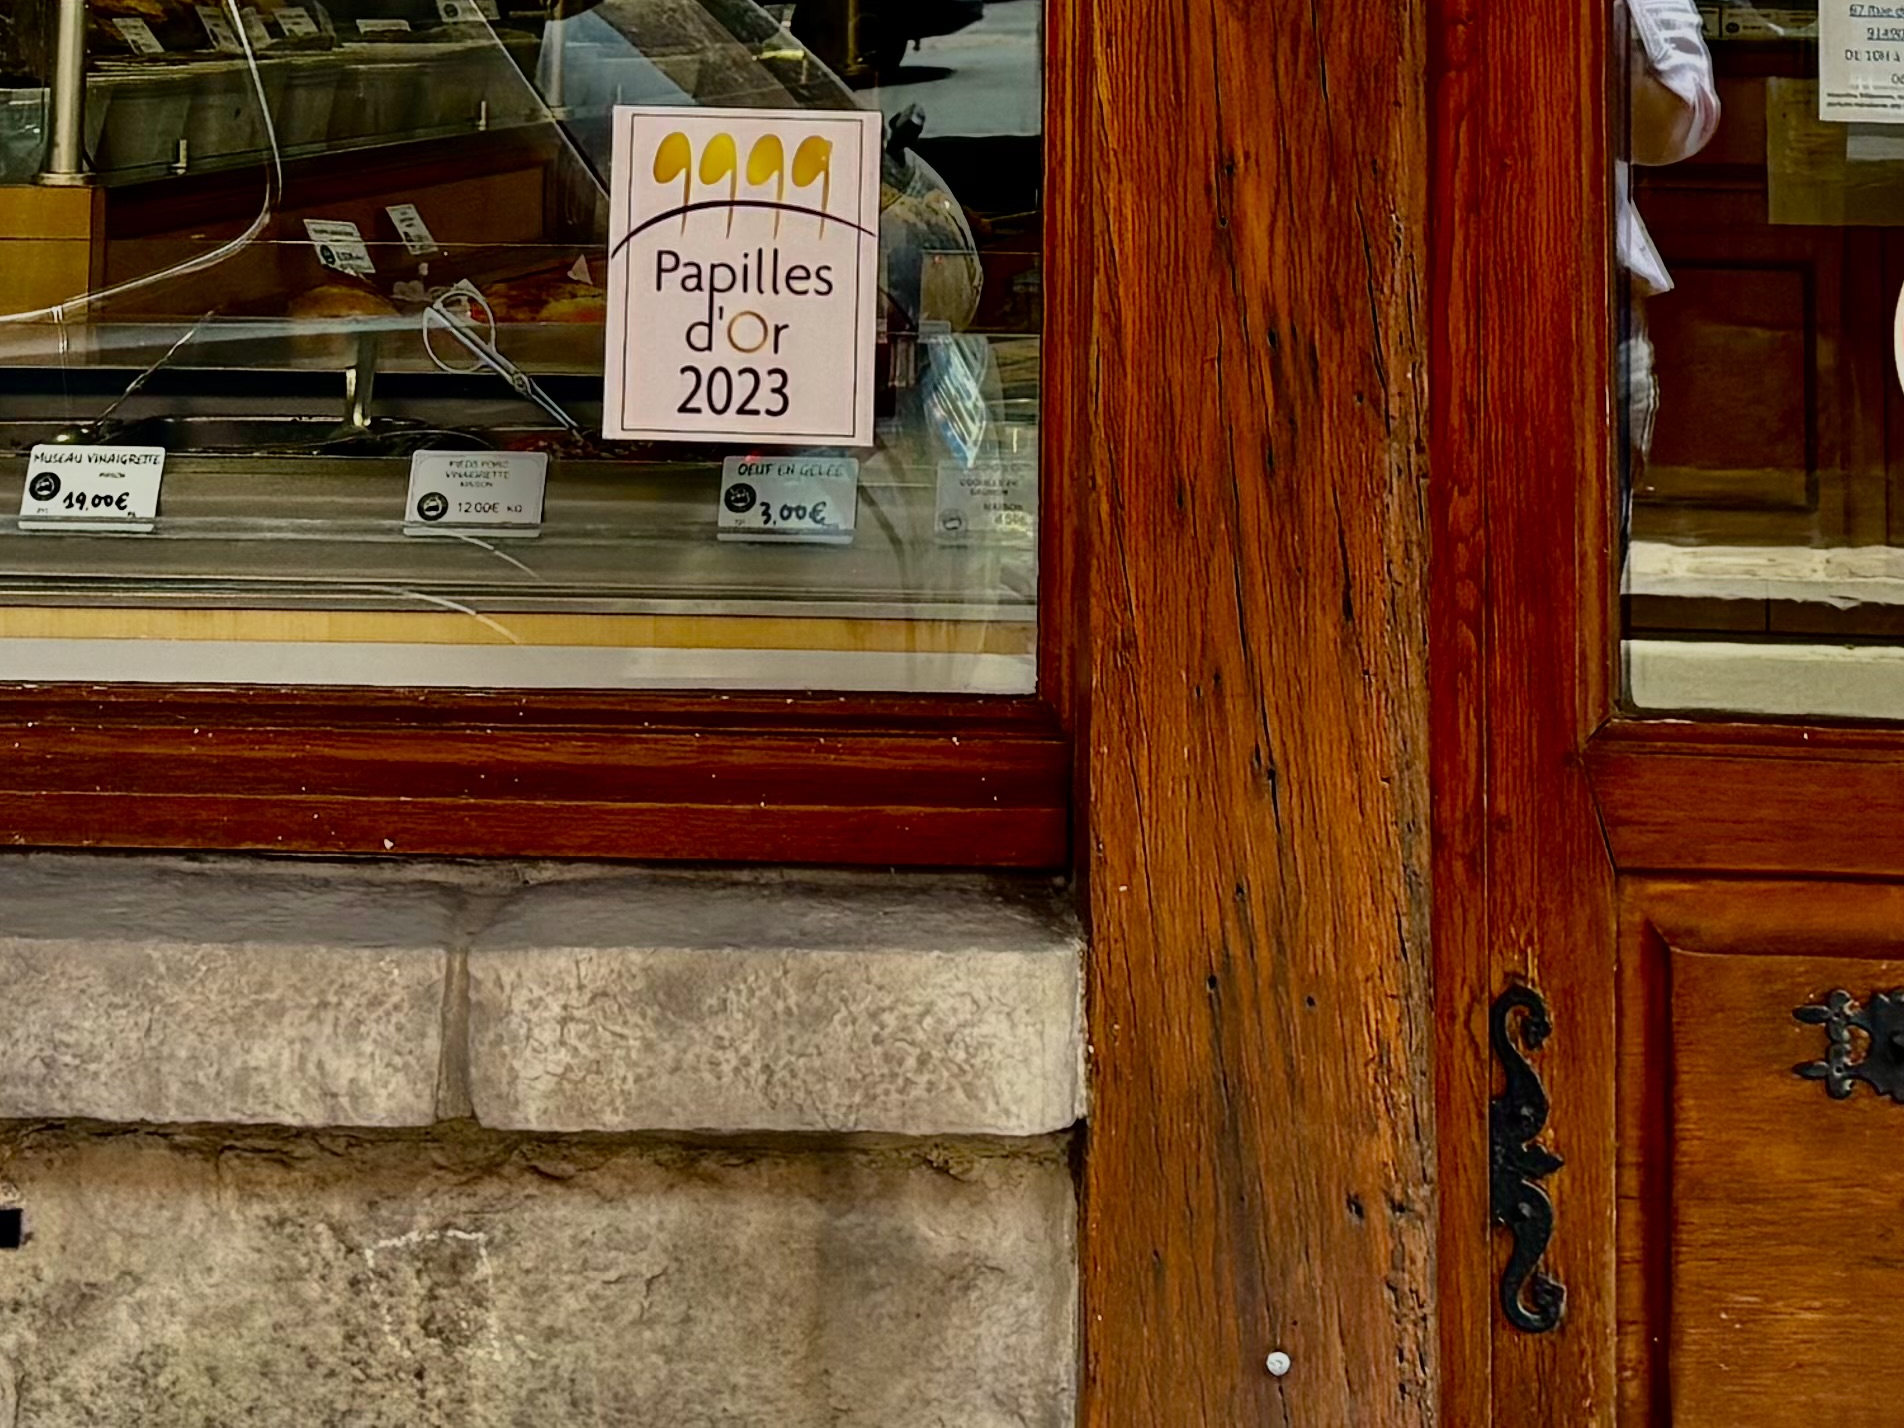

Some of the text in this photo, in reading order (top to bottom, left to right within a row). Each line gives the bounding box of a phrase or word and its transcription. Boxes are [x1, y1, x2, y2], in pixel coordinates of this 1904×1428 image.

[656, 247, 833, 300] Papilles
[685, 302, 790, 355] d'Or
[676, 365, 790, 417] 2023
[87, 453, 161, 465] VINAIGRETTE
[737, 463, 774, 476] OEUF
[777, 463, 796, 476] EN
[62, 491, 130, 511] 19.00€
[759, 501, 827, 526] 3.00€
